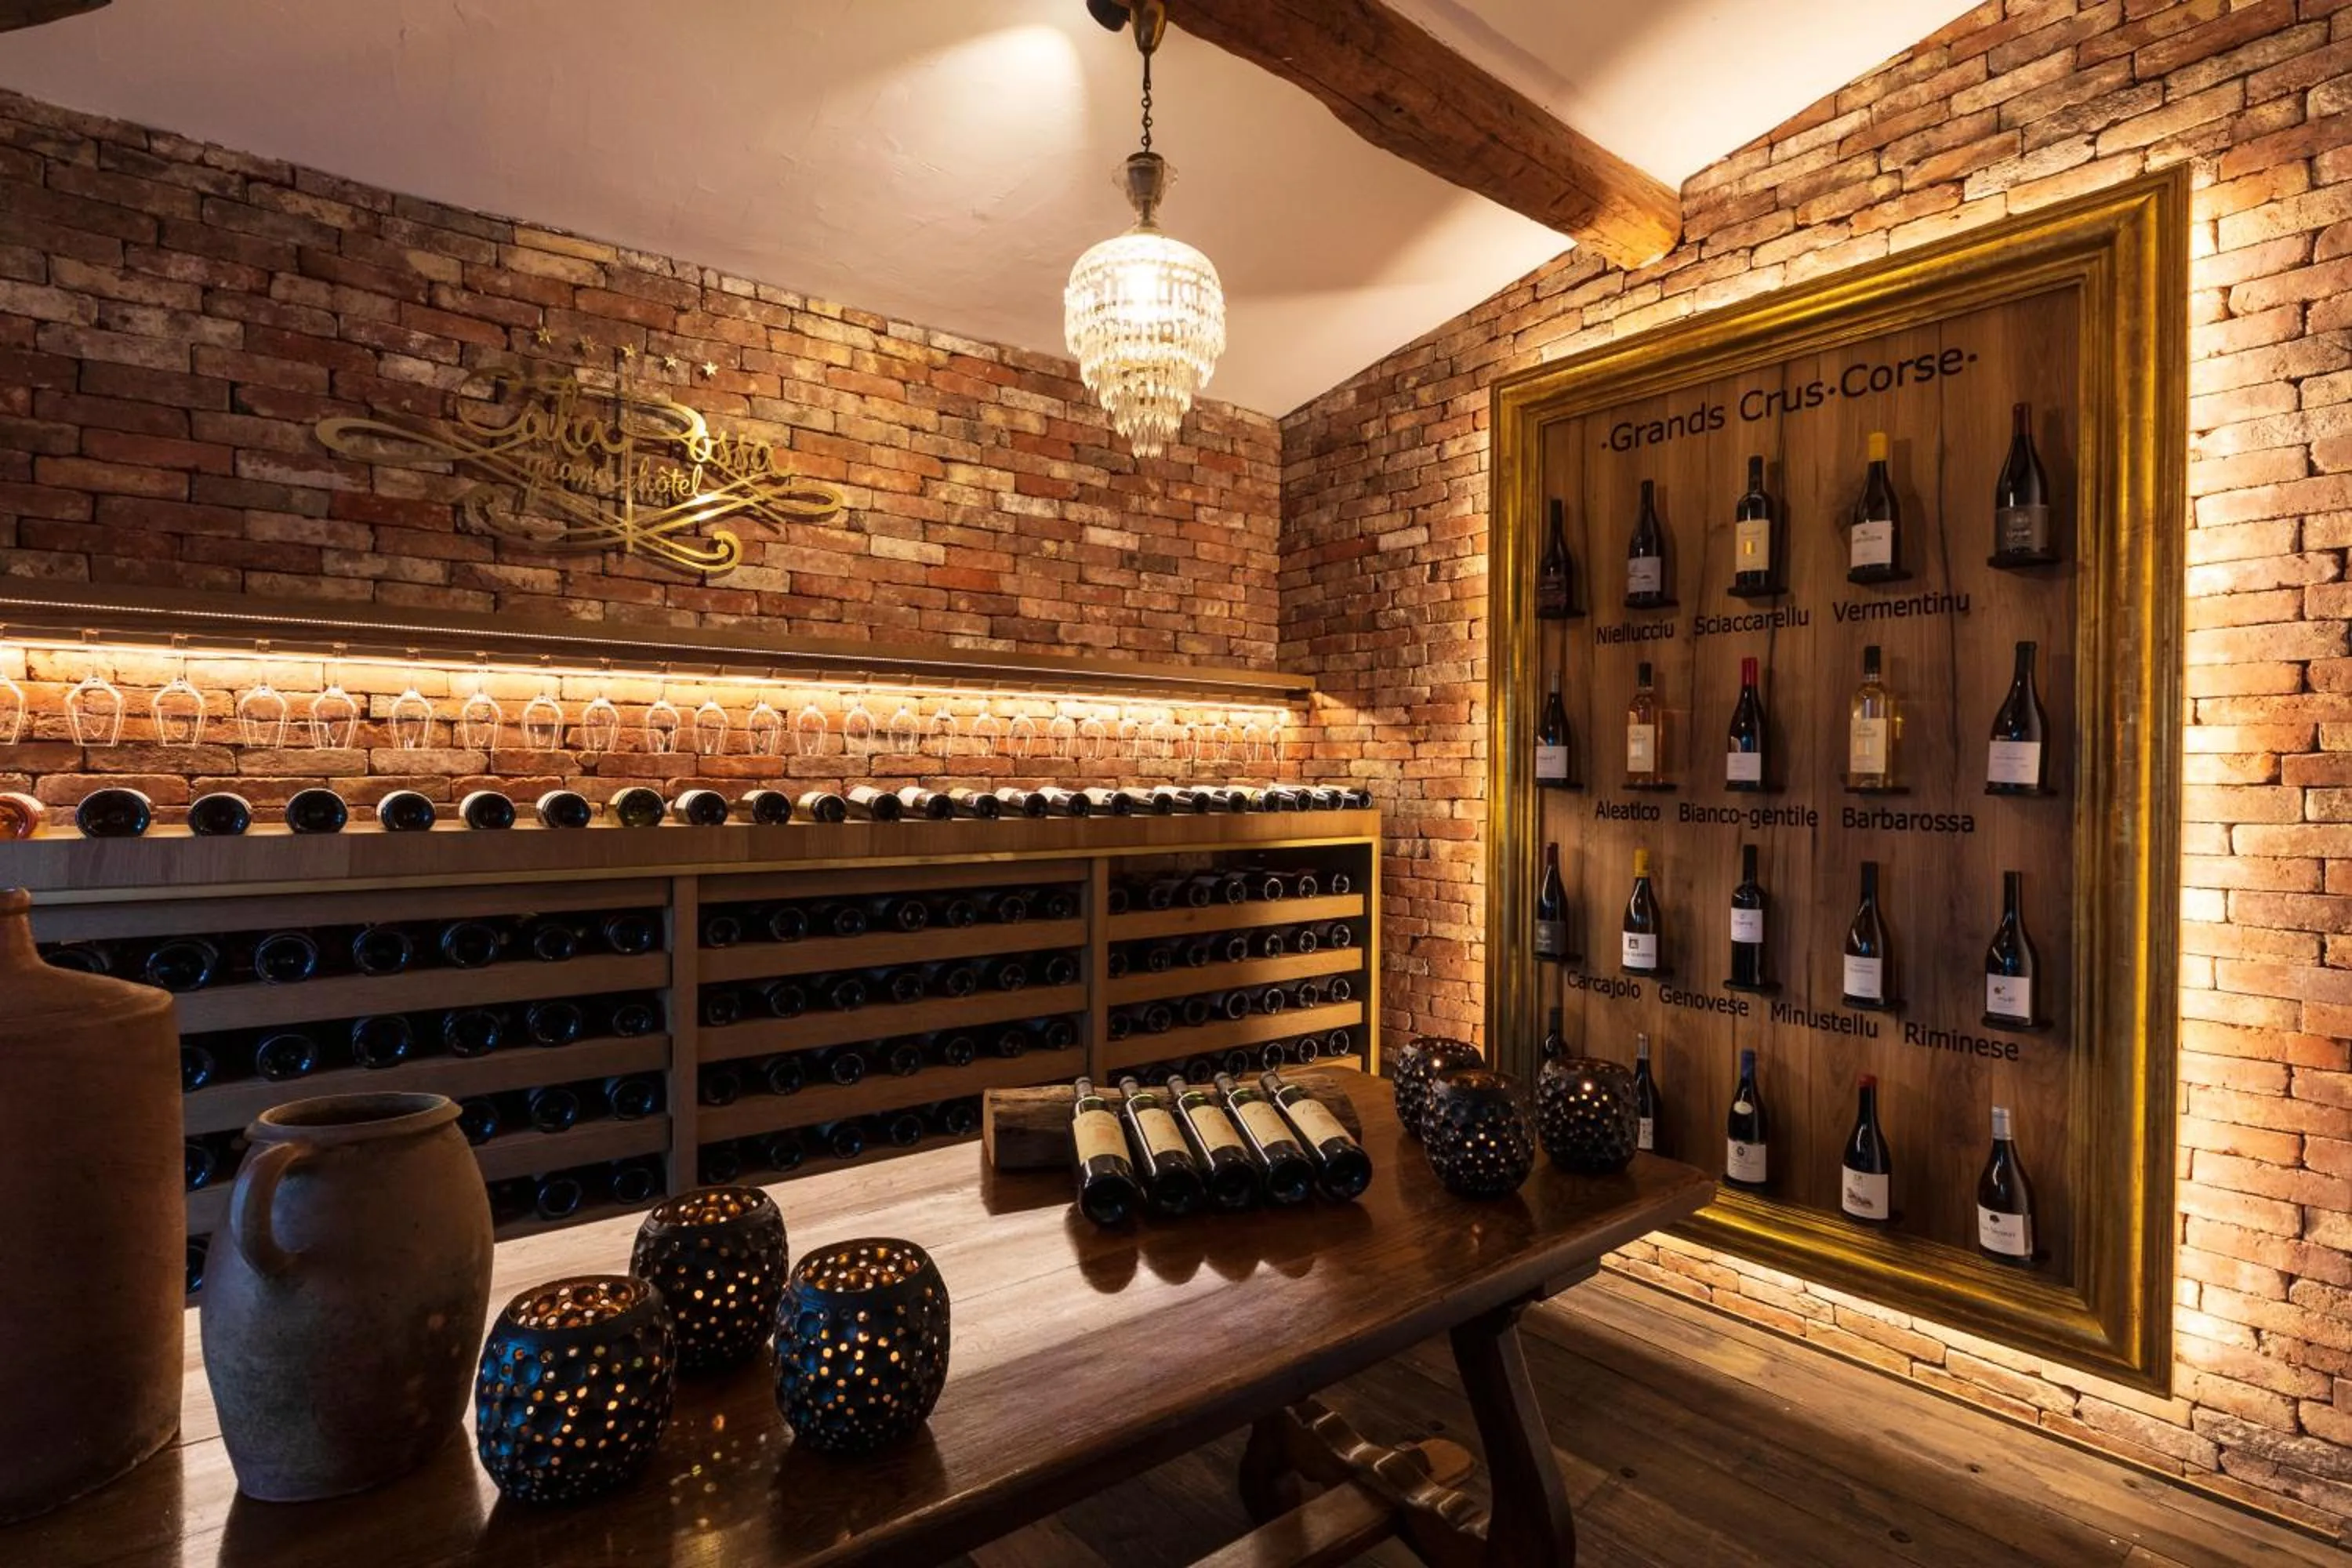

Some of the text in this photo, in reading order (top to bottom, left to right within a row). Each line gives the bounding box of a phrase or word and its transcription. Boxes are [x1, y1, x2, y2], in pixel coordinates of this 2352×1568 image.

[456, 366, 630, 456] Cala
[632, 457, 704, 499] hôtel
[1595, 591, 1971, 645] Niellucciu Sciaccarellu Vermentinu
[1595, 800, 1976, 833] Aleatico Bianco-gentile Barbarossa
[1566, 970, 2020, 1062] Carcajolo Genovese Minustellu Riminese
